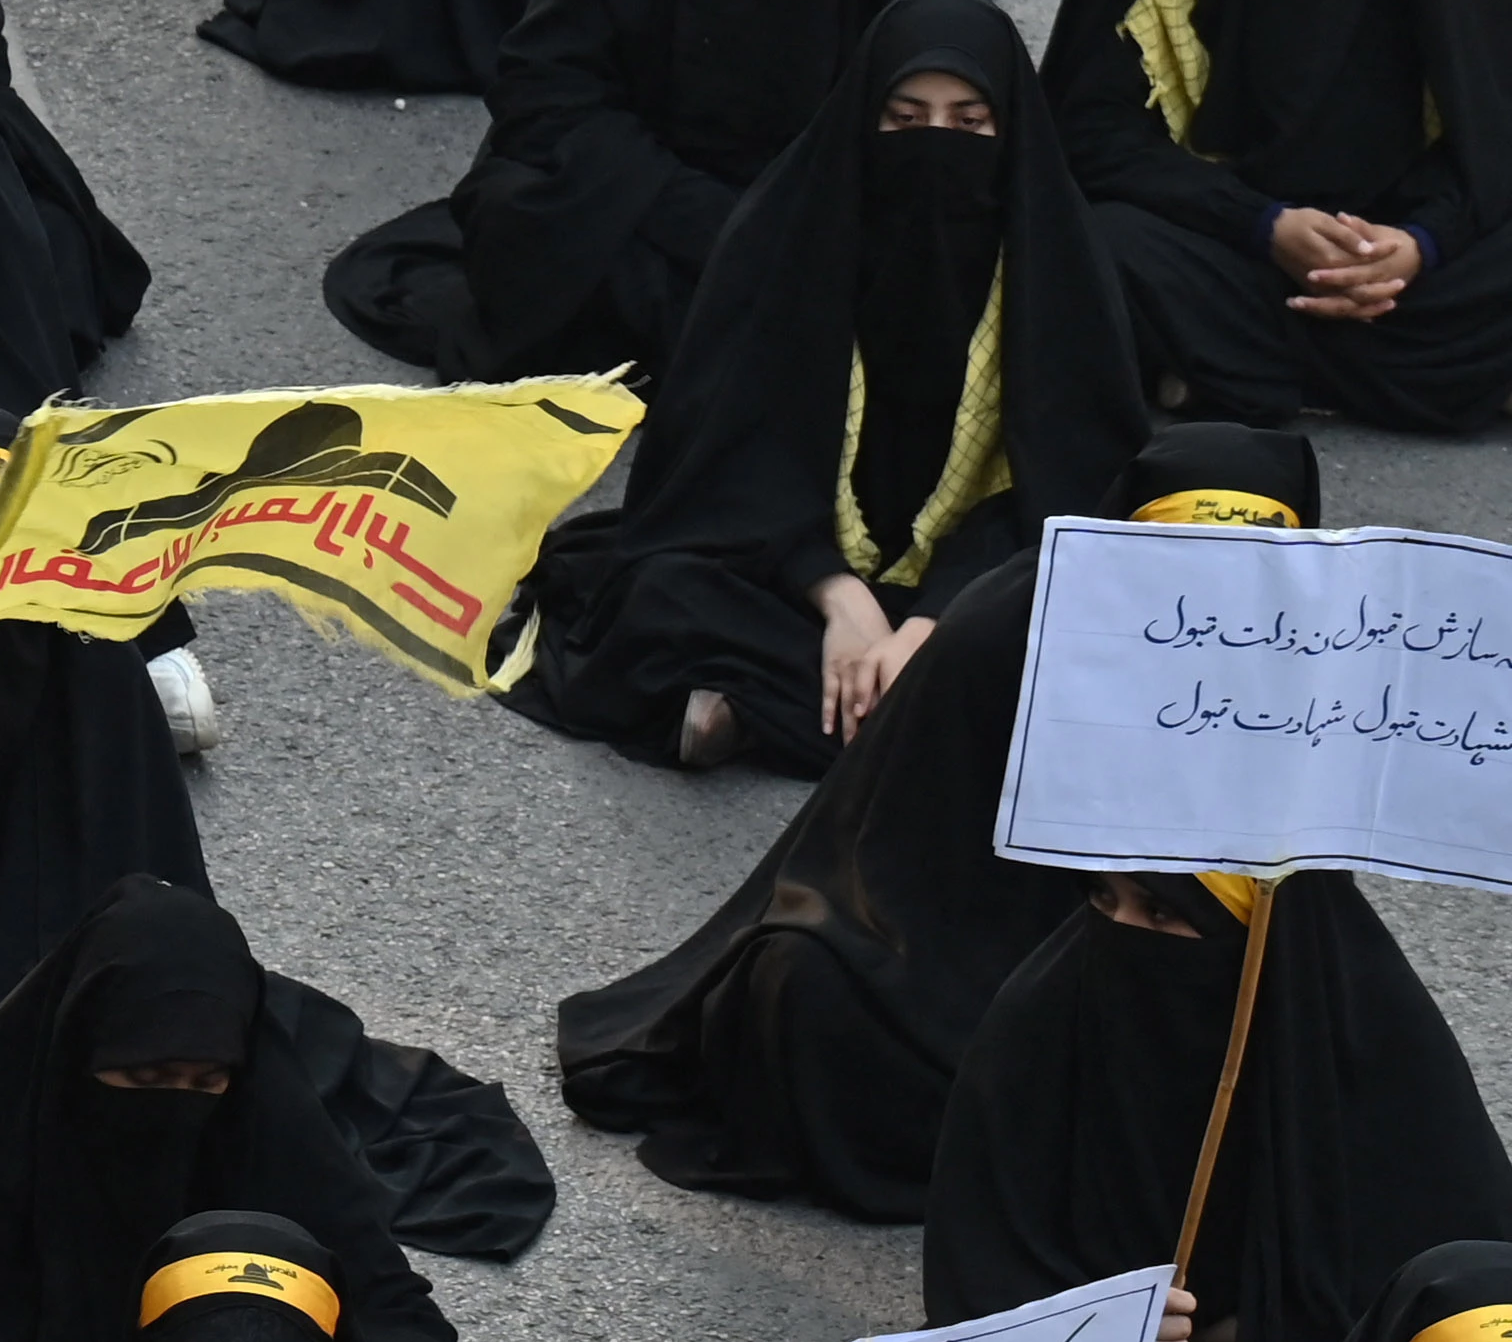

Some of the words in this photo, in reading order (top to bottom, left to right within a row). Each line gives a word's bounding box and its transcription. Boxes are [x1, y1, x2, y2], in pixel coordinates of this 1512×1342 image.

[1144, 594, 1218, 647] قبول
[1332, 594, 1403, 652] قبول
[1156, 680, 1232, 736] قبول
[1353, 684, 1418, 742] قبول
